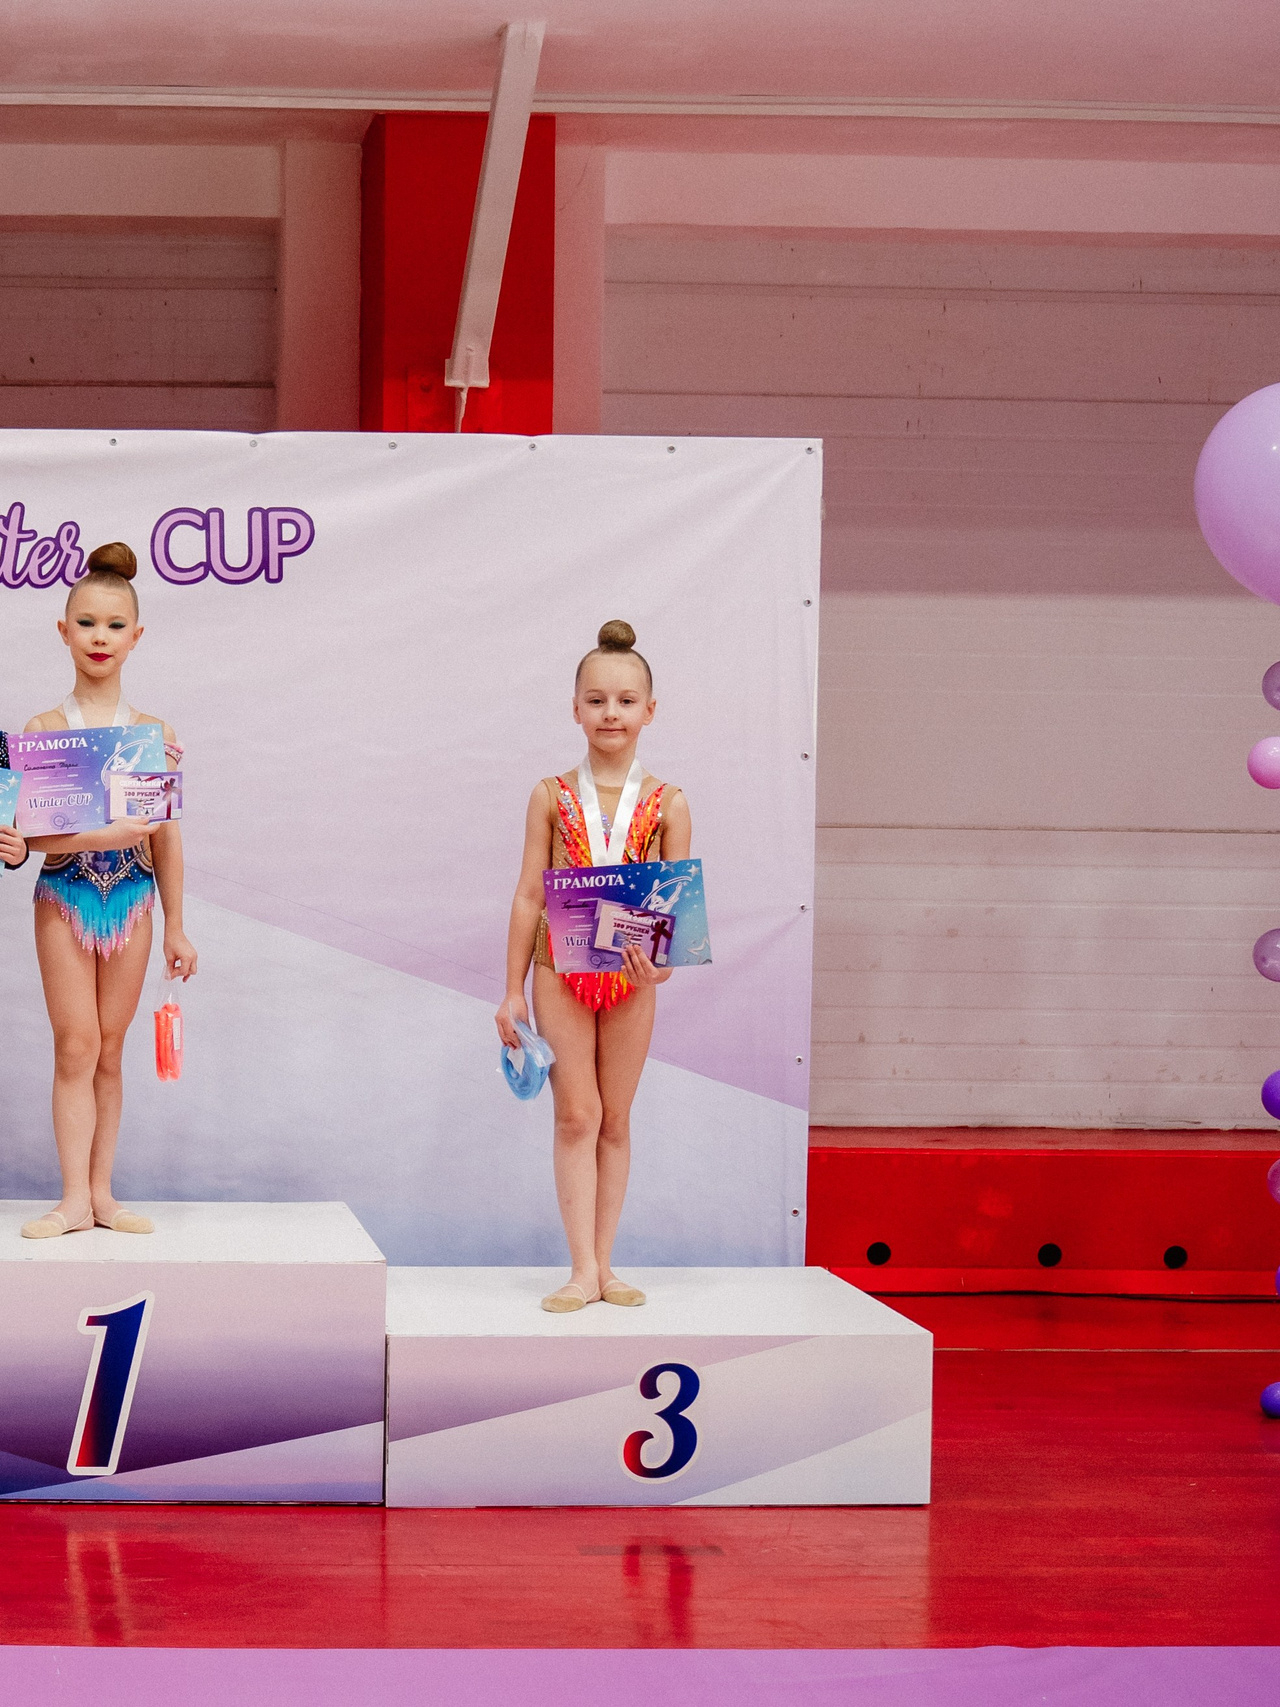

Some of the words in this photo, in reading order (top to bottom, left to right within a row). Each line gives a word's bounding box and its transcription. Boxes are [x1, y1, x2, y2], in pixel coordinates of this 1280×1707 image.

[149, 506, 315, 586] CUP
[17, 737, 88, 753] ГРАМОТА
[26, 797, 66, 810] Winter
[66, 792, 93, 807] CUP
[553, 873, 625, 890] ГРАМОТА
[625, 925, 650, 935] РУБЛЕЙ
[66, 1290, 156, 1477] 1
[621, 1357, 702, 1484] 3
